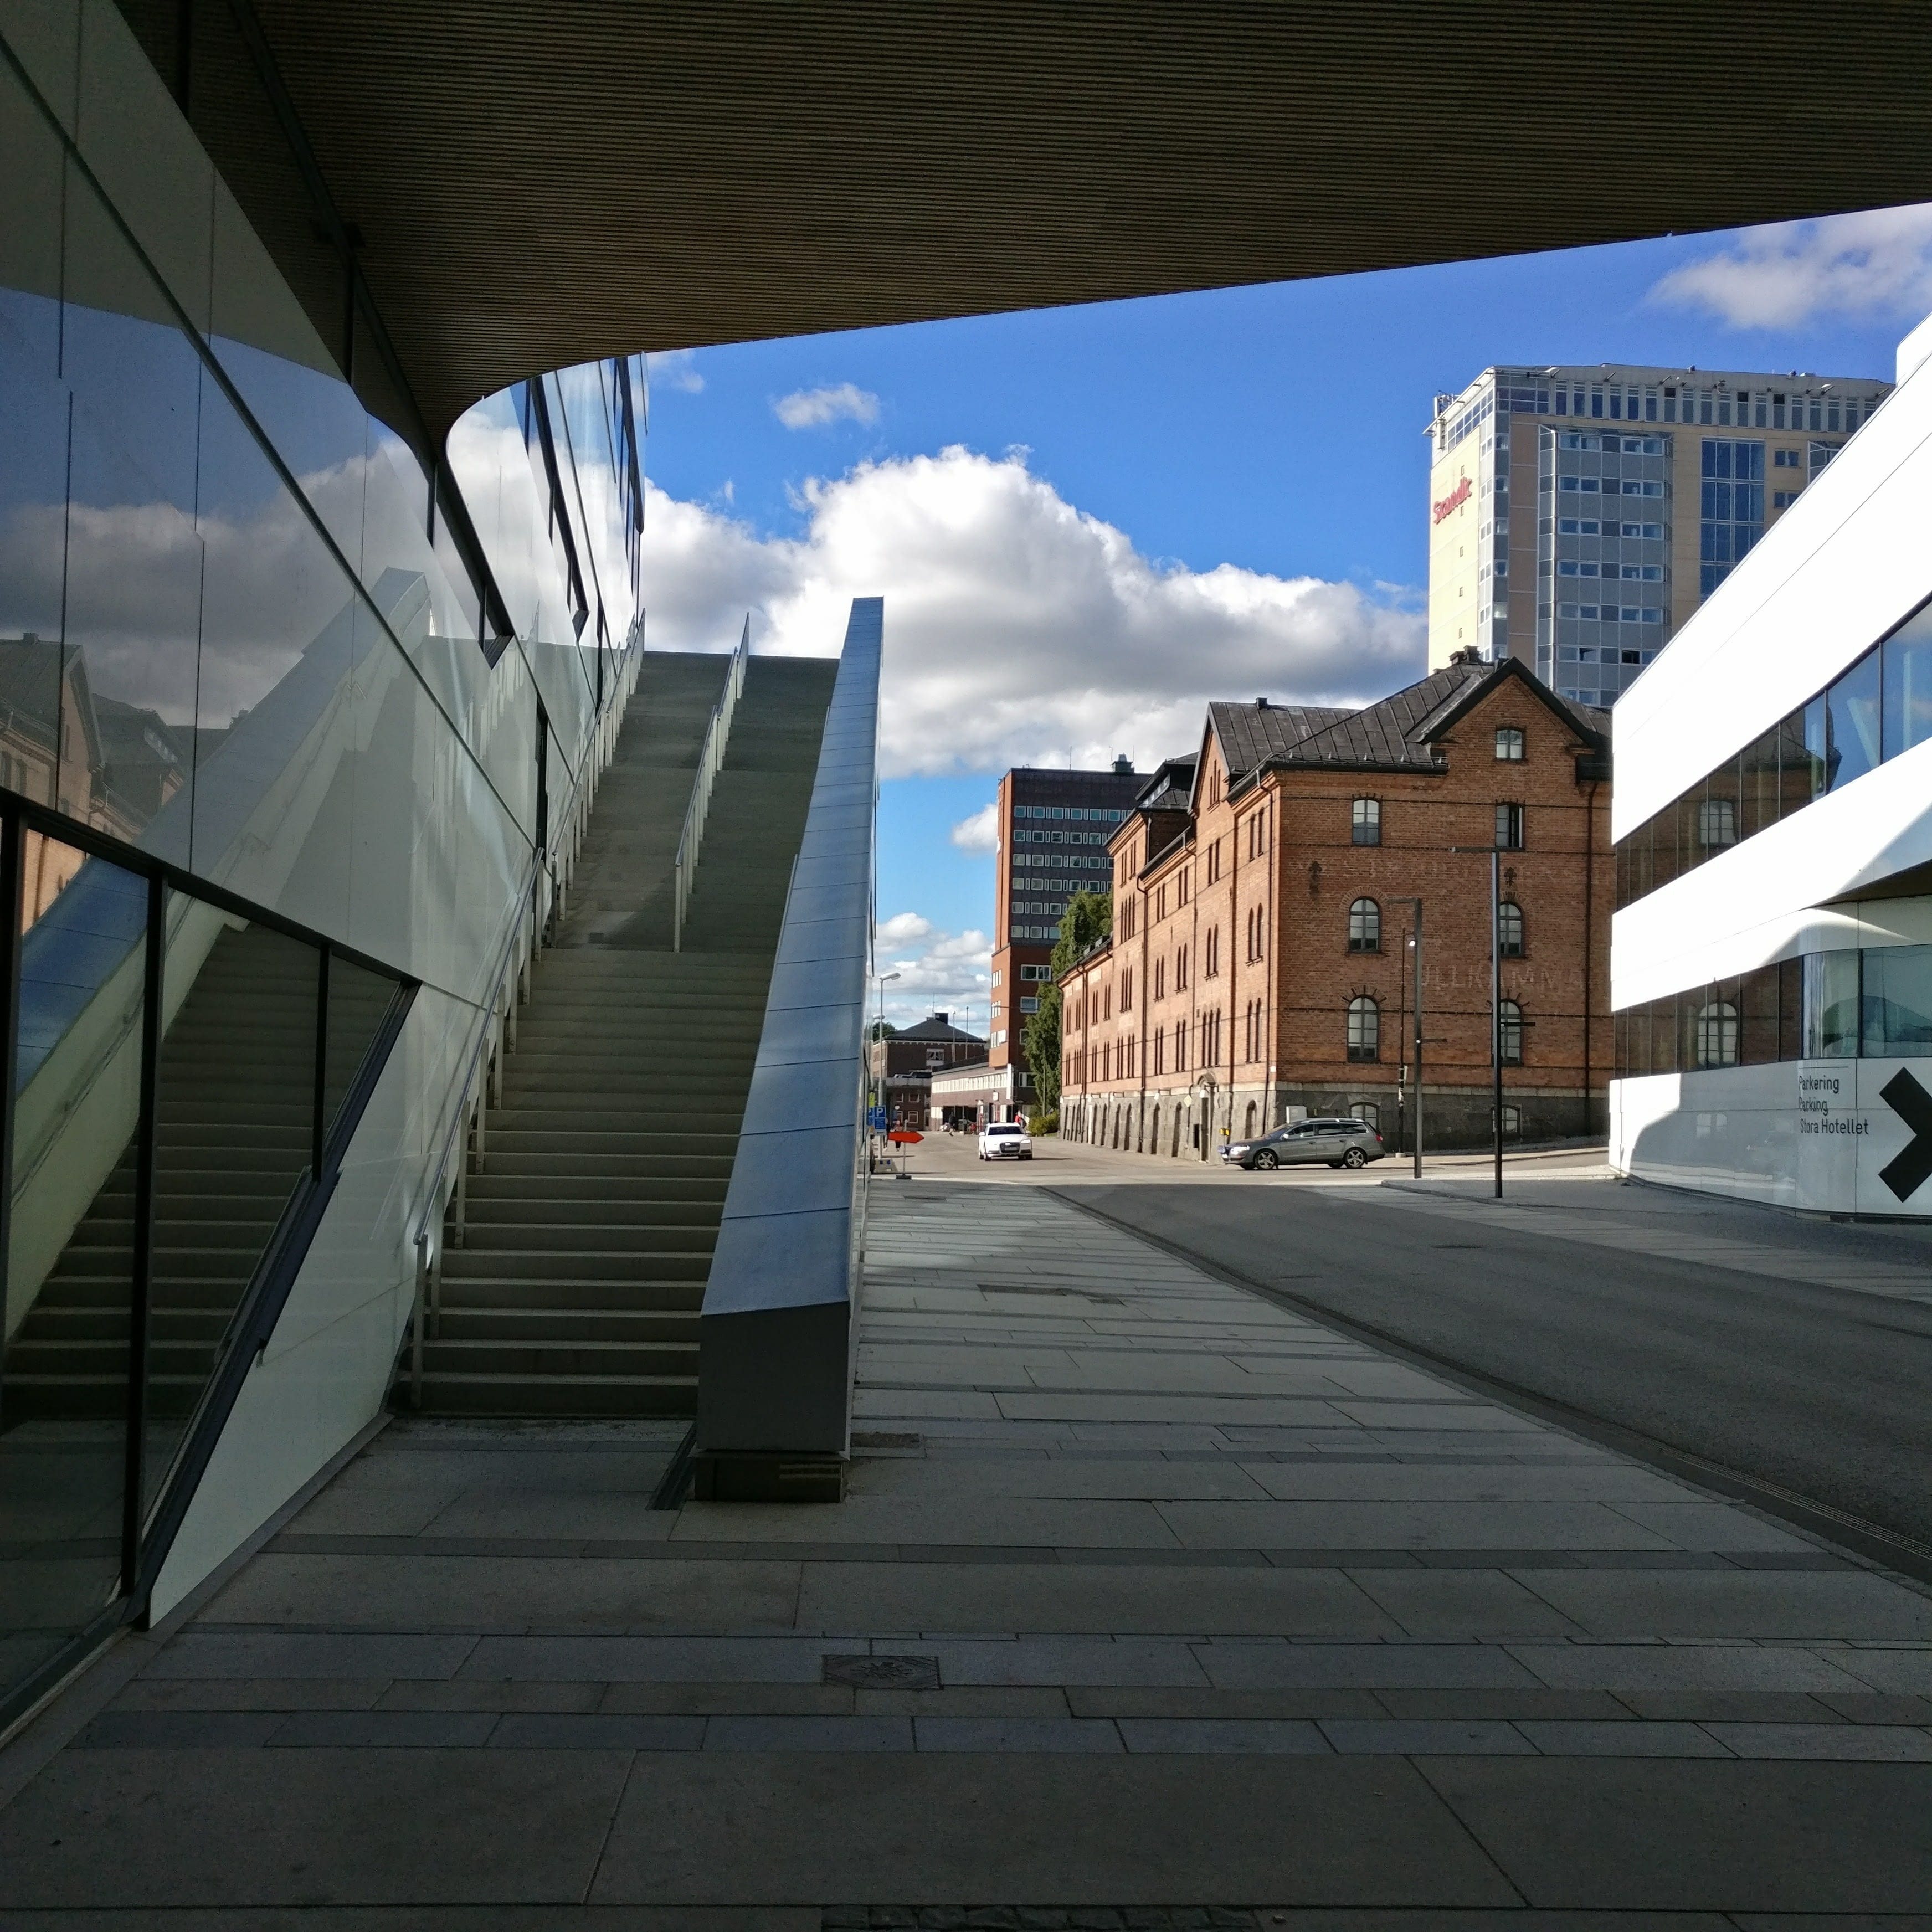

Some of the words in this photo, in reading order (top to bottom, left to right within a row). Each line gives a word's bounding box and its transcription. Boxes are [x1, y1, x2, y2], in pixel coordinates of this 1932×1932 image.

[1433, 476, 1473, 525] Scandic
[1799, 1075, 1839, 1094] Parkering
[876, 1107, 883, 1117] P
[1799, 1096, 1828, 1116] Parking
[1800, 1118, 1820, 1133] Stora
[1821, 1118, 1869, 1135] Hotellet
